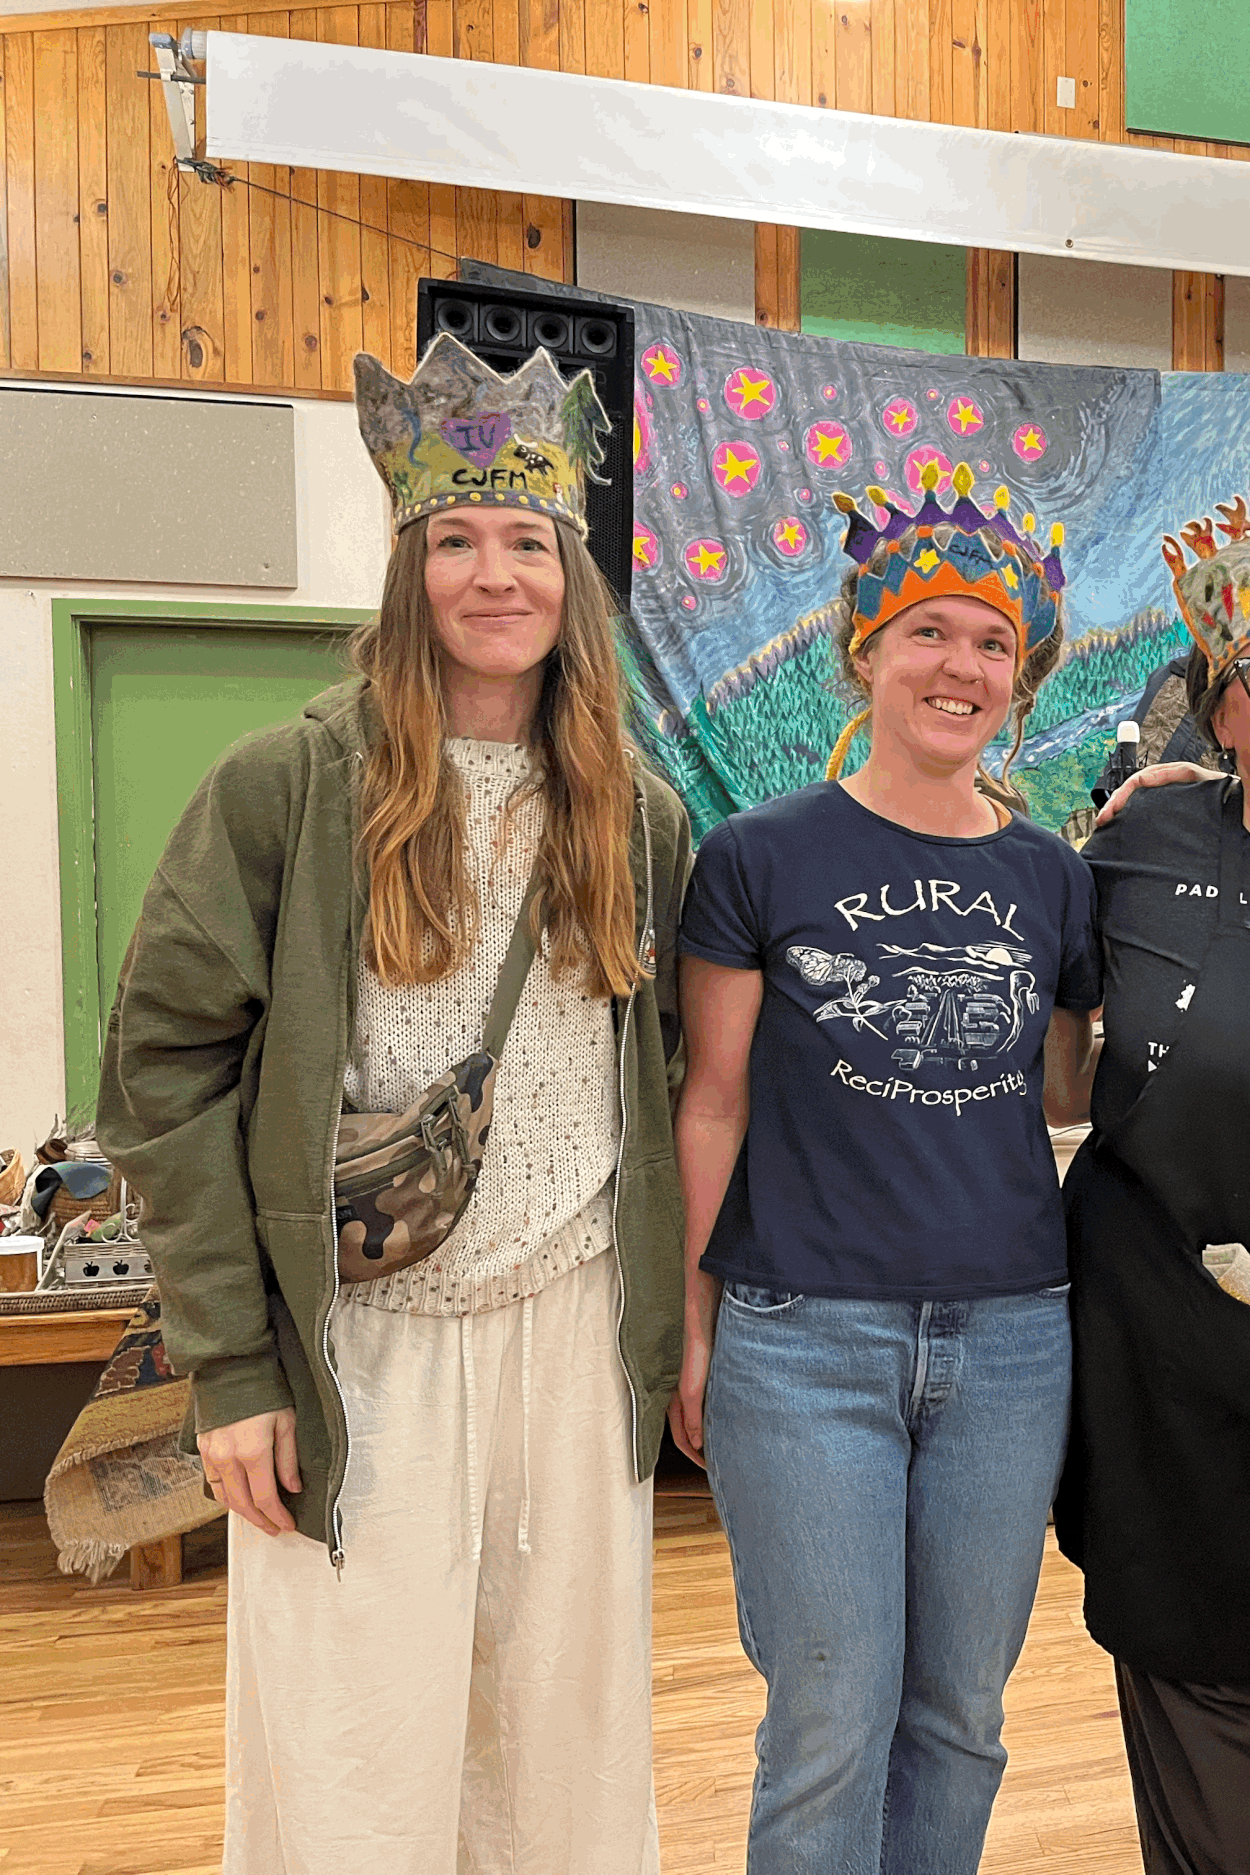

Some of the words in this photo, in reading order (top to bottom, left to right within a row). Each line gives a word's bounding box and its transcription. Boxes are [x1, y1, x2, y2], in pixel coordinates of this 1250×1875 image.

[451, 468, 528, 489] CJFM
[834, 879, 1024, 941] RURAL
[830, 1059, 1027, 1117] ReciProsperity
